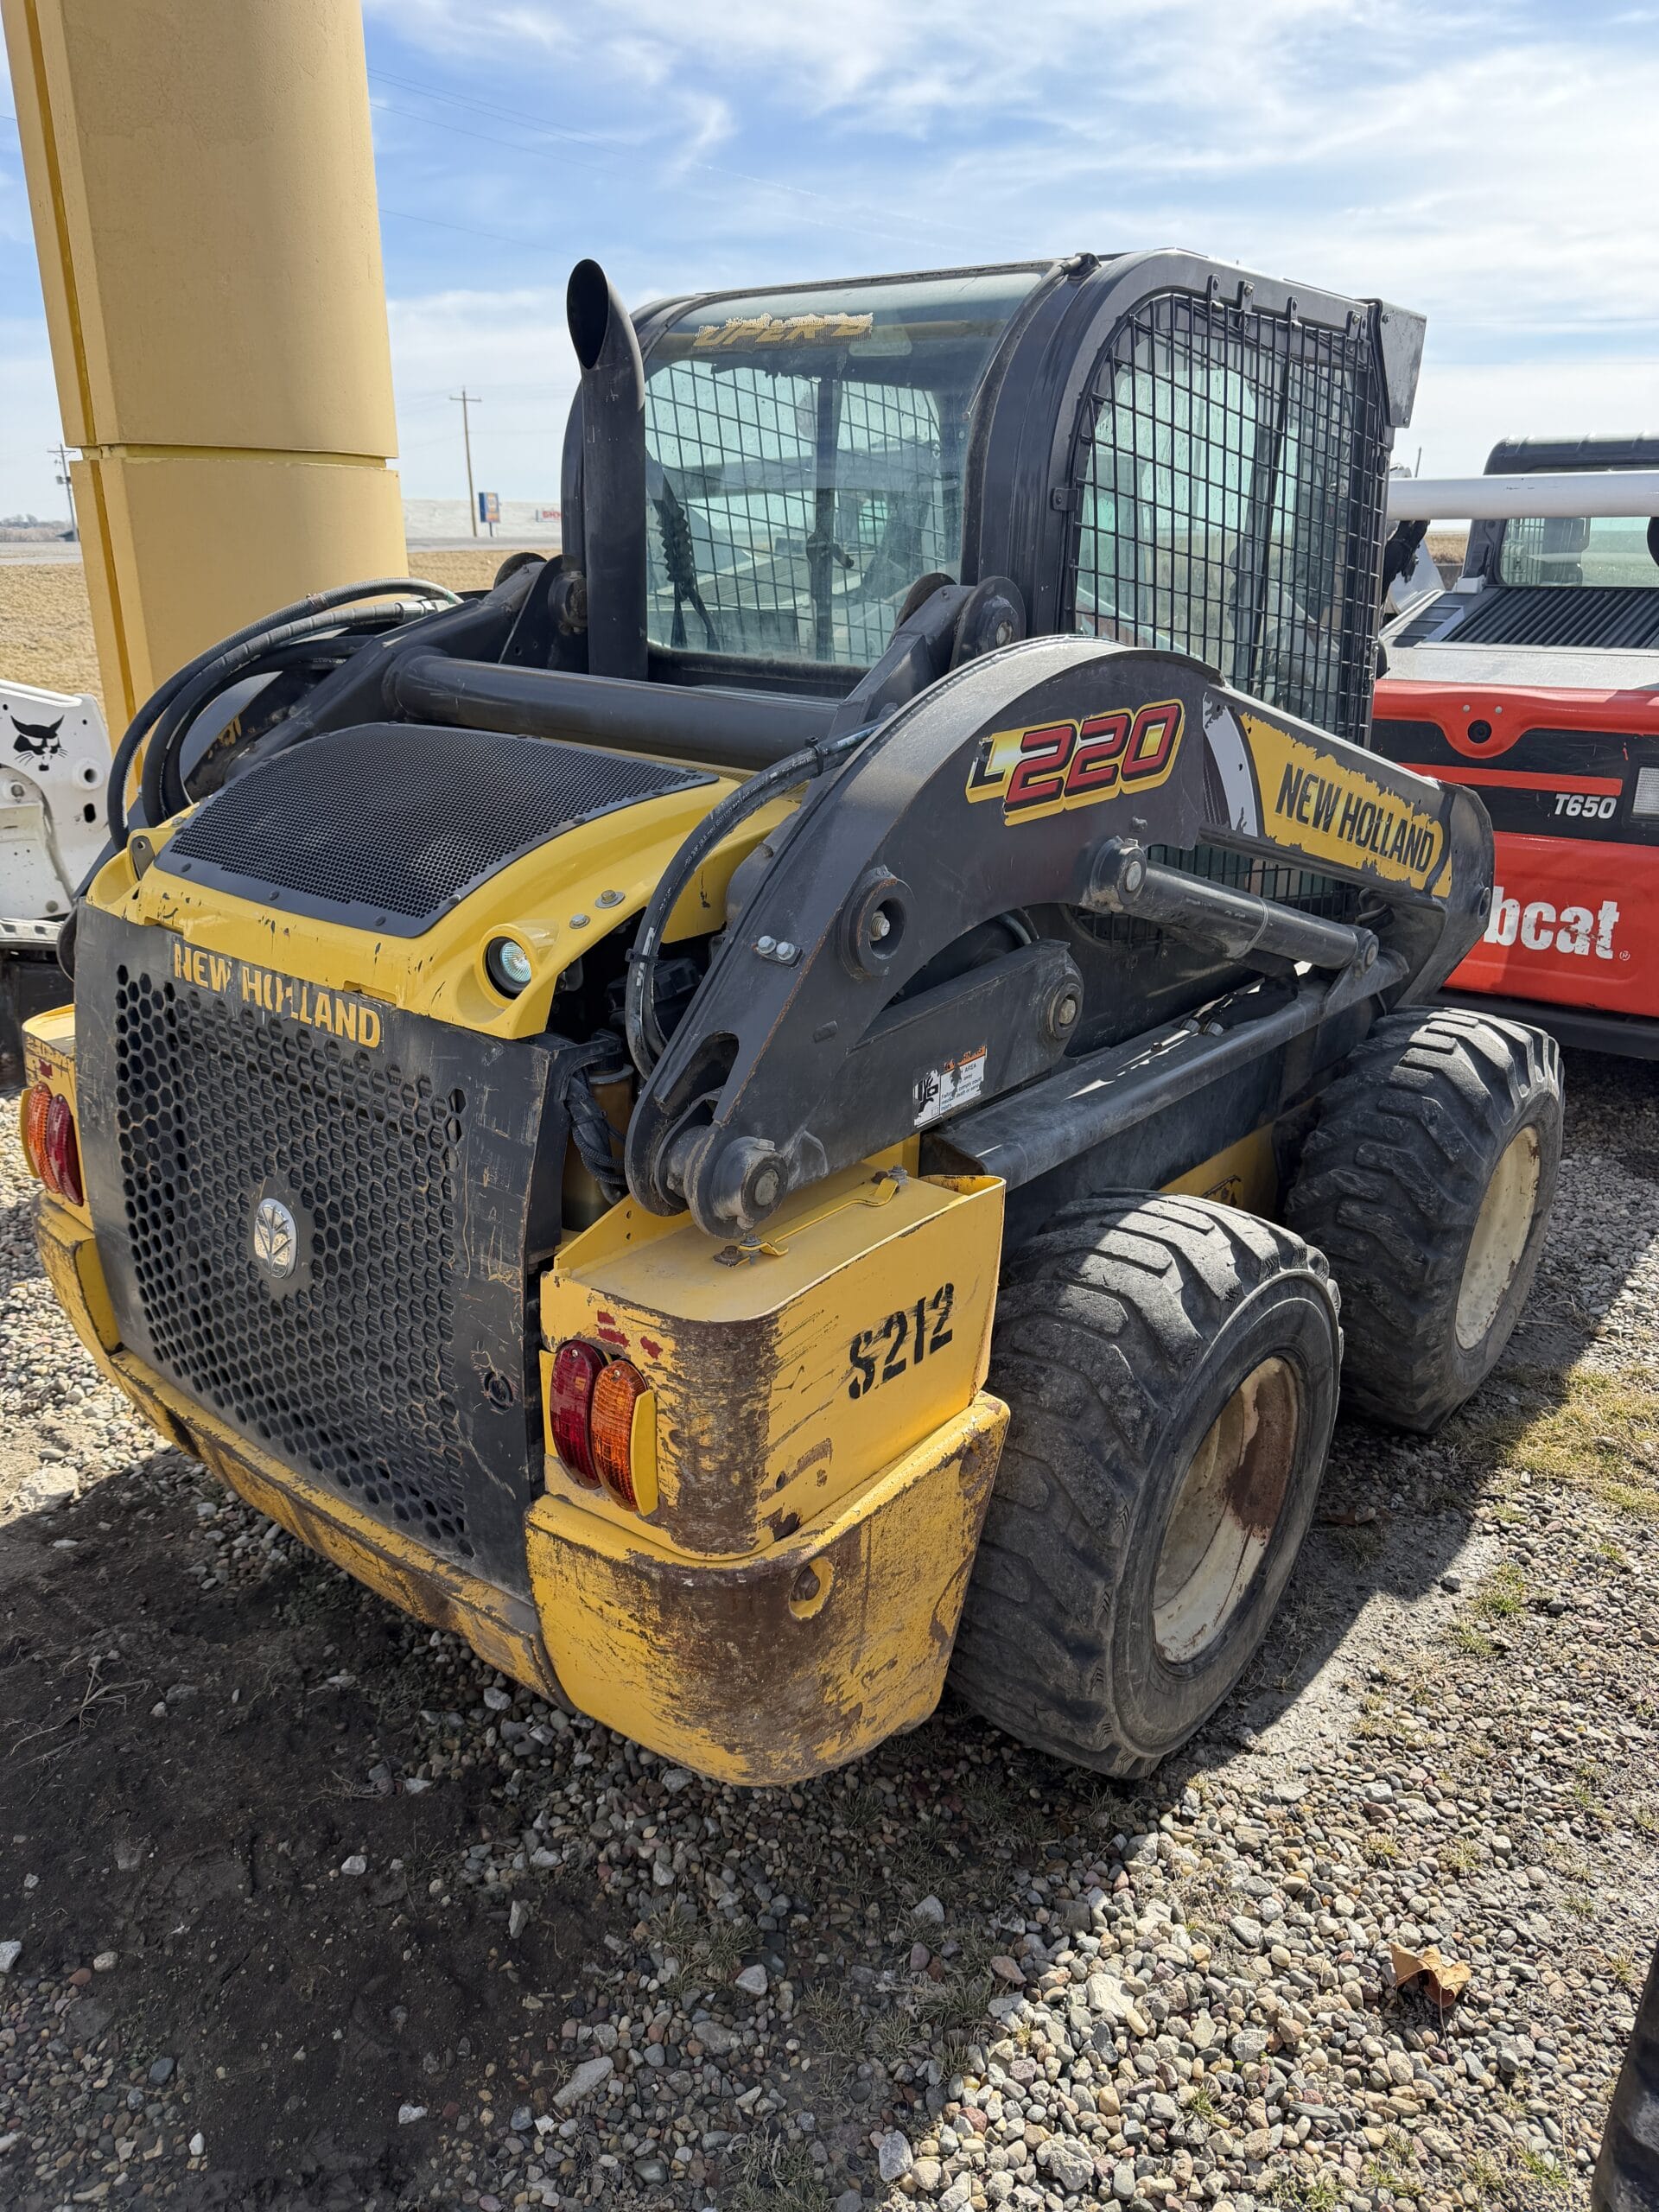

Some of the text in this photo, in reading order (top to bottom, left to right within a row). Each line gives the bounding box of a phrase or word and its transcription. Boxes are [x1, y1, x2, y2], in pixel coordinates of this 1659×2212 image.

[966, 701, 1185, 824] L220
[1554, 792, 1618, 820] T650
[1274, 761, 1435, 874] NEW HOLLAND
[1484, 886, 1620, 959] bcat
[174, 943, 382, 1049] NEW HOLLAND
[849, 1282, 955, 1400] S212
